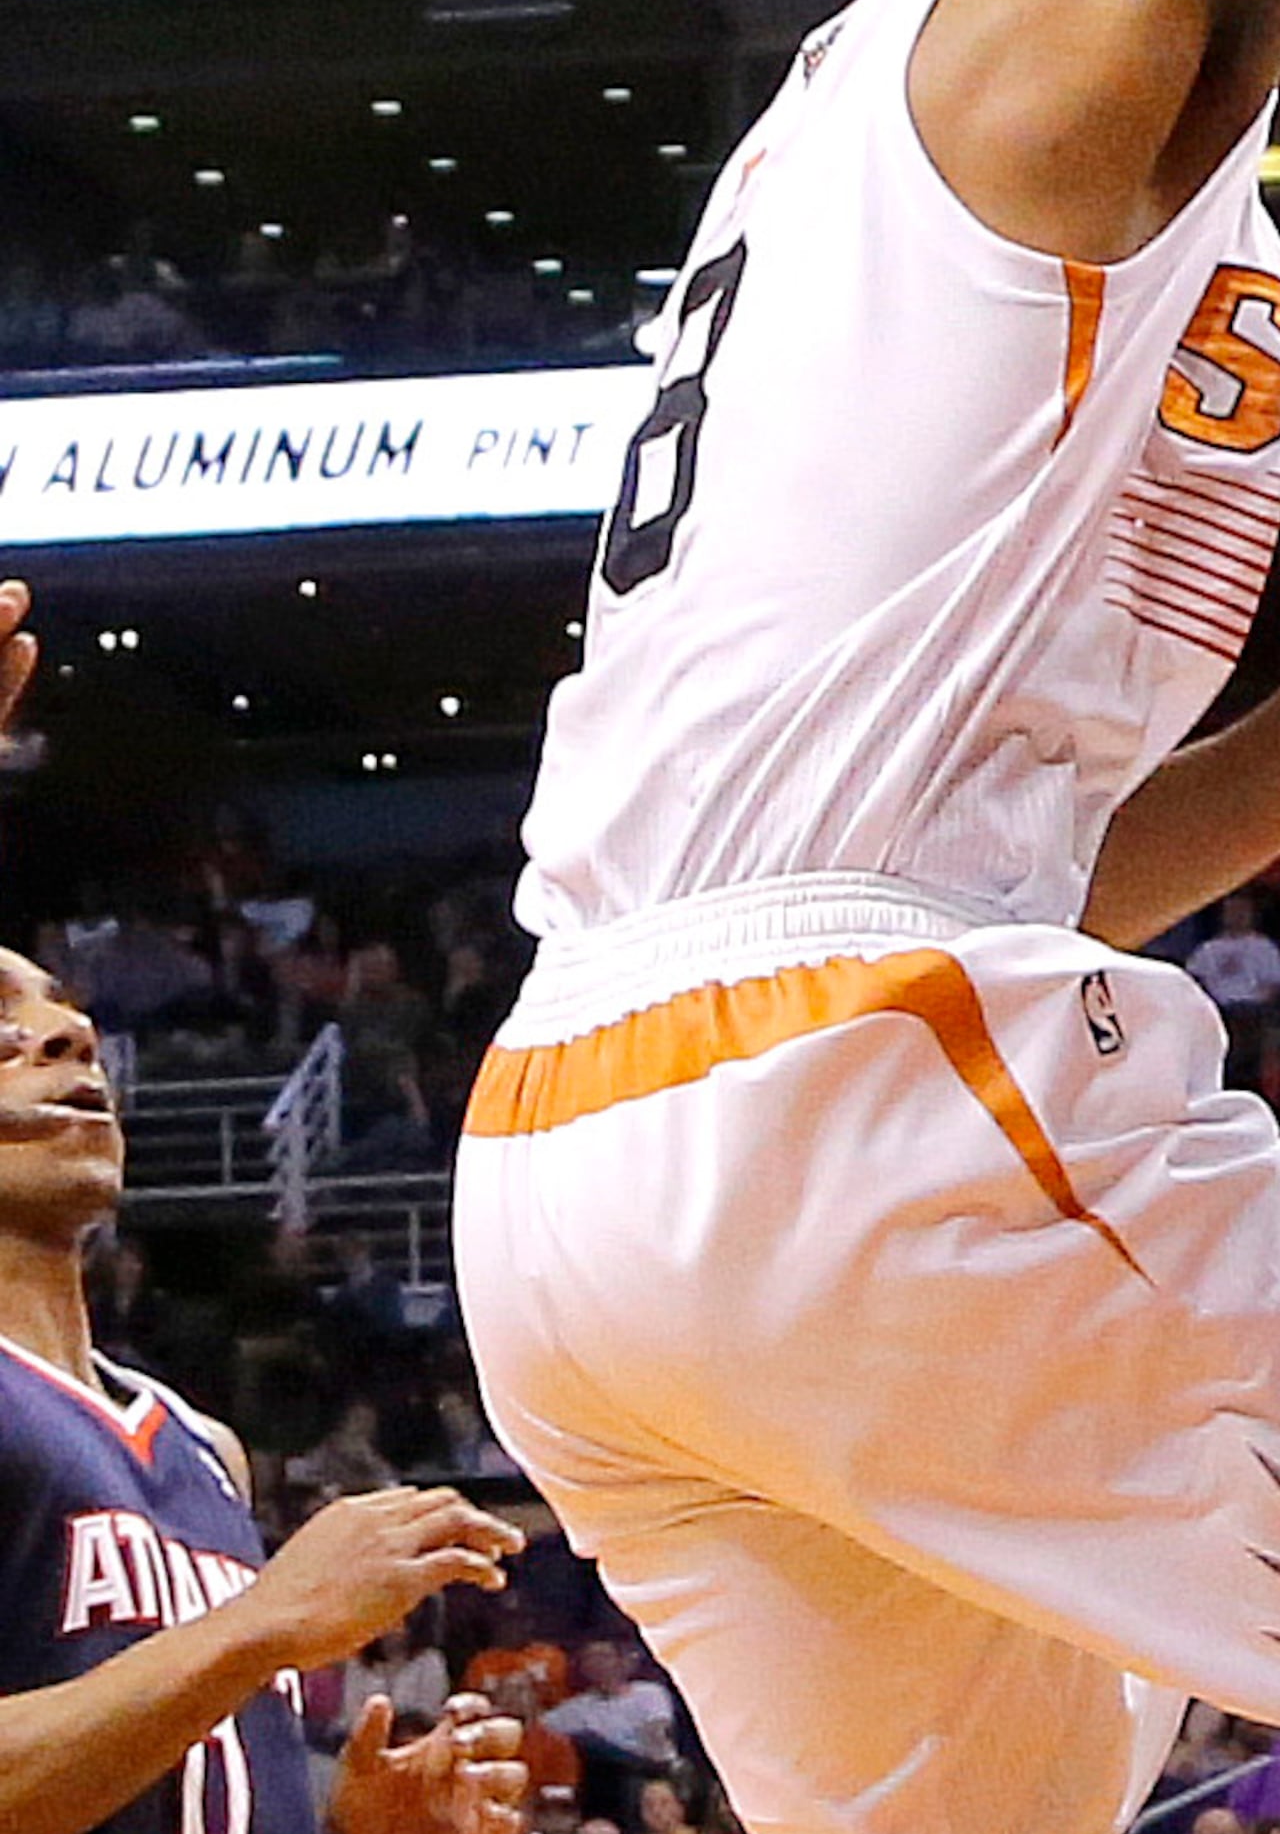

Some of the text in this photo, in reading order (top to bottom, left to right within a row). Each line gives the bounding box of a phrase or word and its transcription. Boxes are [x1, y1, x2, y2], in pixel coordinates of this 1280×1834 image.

[42, 418, 426, 494] ALUMINUM
[466, 422, 595, 471] PINT
[601, 230, 749, 596] 8
